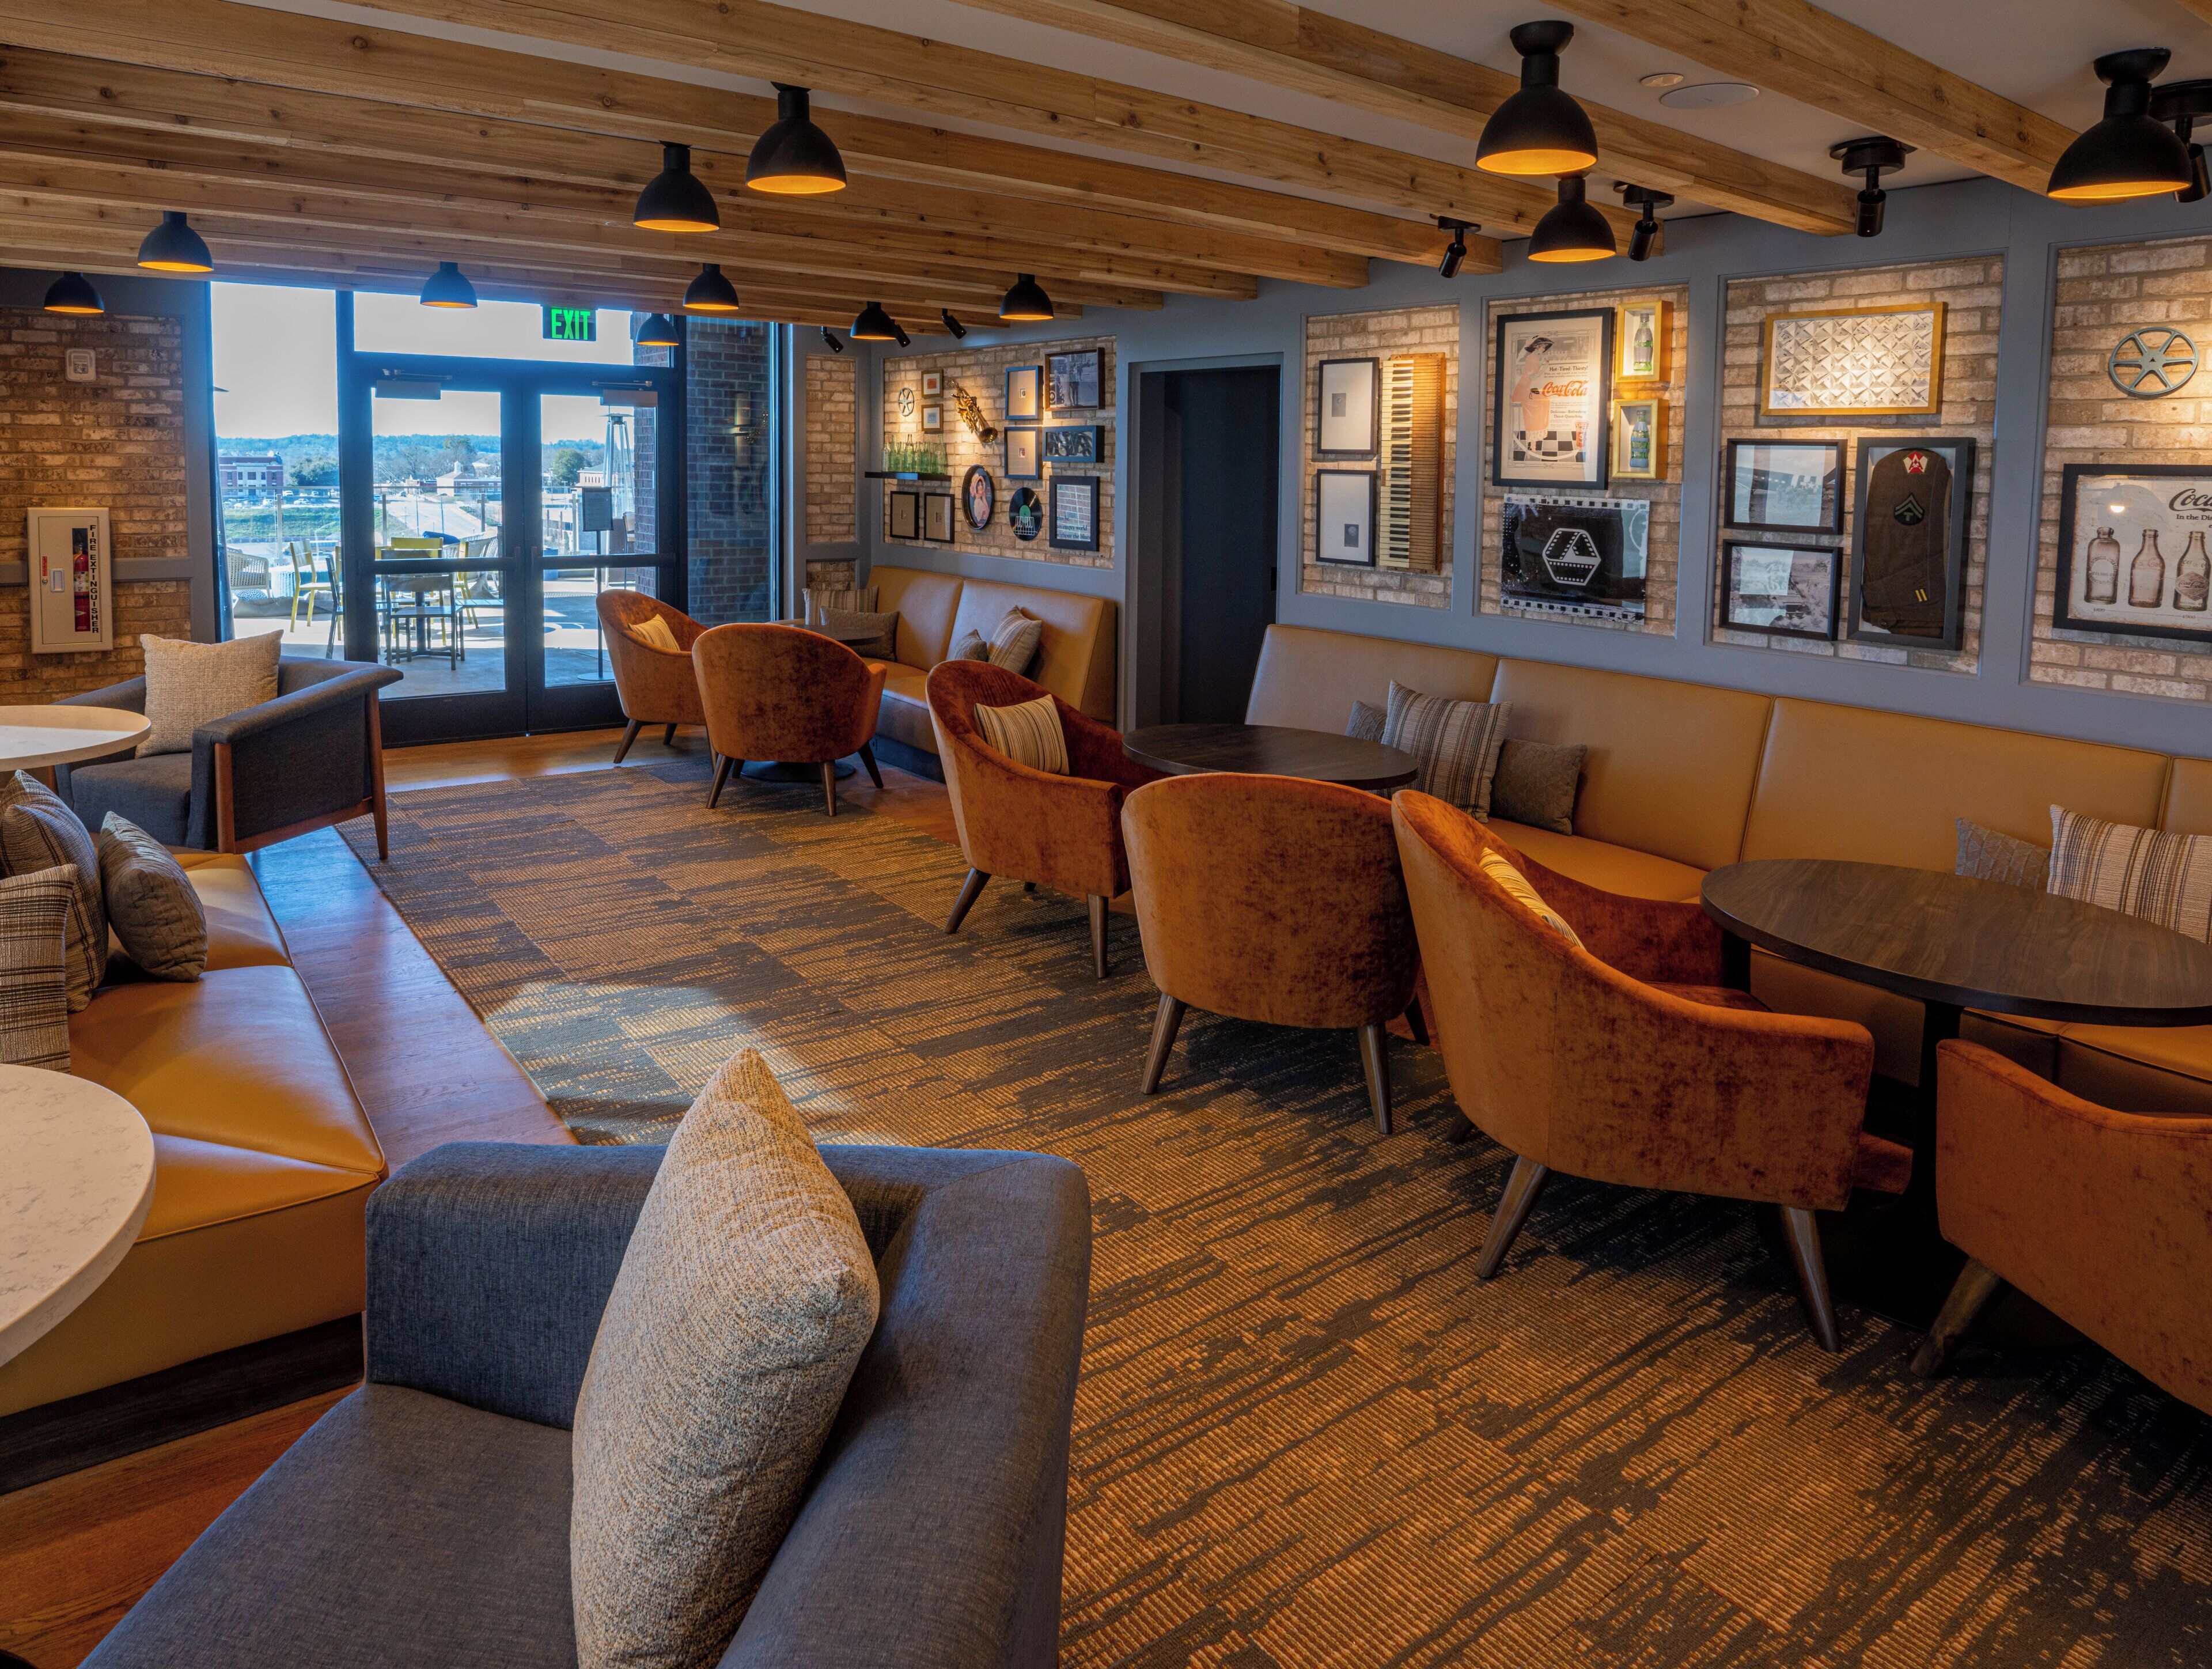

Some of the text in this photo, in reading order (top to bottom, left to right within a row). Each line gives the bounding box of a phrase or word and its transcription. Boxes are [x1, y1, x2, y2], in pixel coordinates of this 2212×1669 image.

[551, 308, 591, 340] EXIT
[1541, 380, 1589, 398] Coca-Cola
[90, 554, 99, 633] EXTINGUISHER
